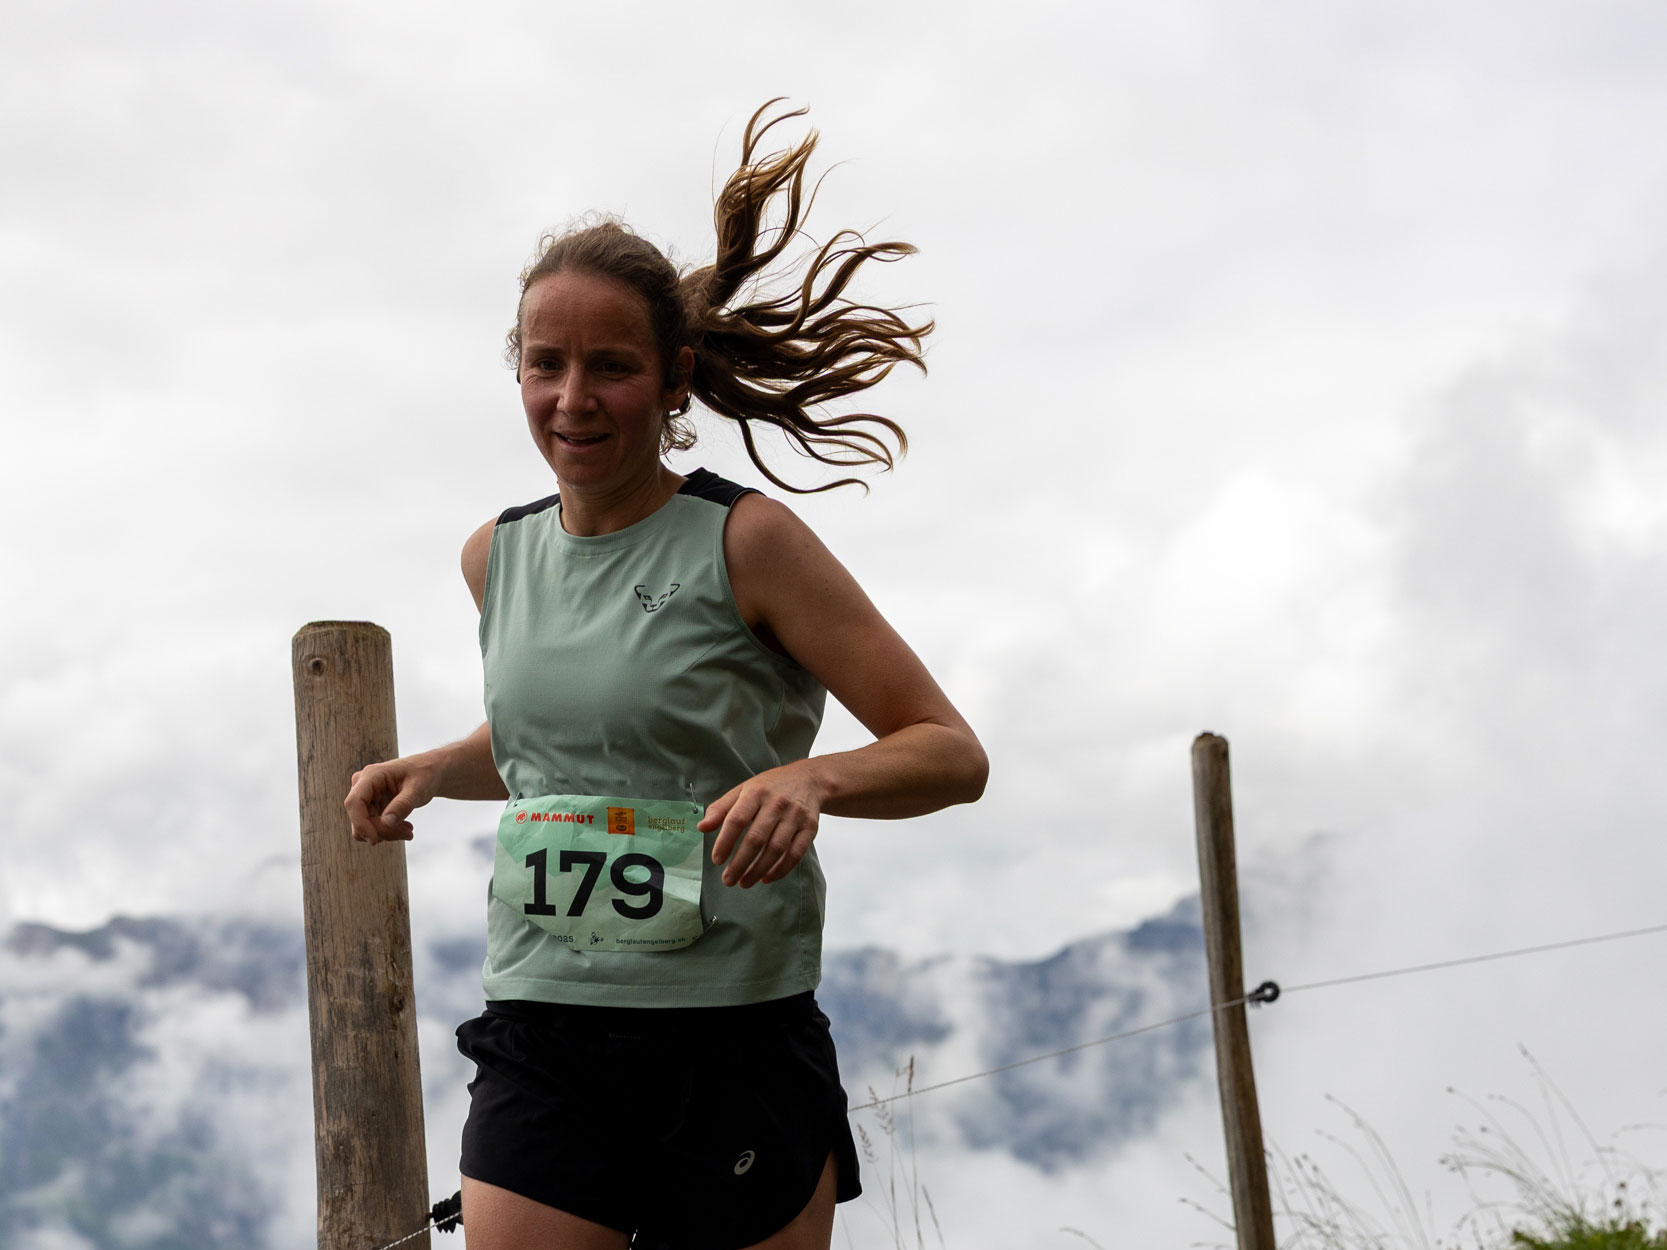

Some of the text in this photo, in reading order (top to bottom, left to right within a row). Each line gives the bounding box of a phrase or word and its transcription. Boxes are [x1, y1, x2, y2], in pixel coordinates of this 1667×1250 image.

[531, 812, 595, 825] MAMMUT
[648, 816, 685, 826] berglauf
[524, 848, 665, 920] 179
